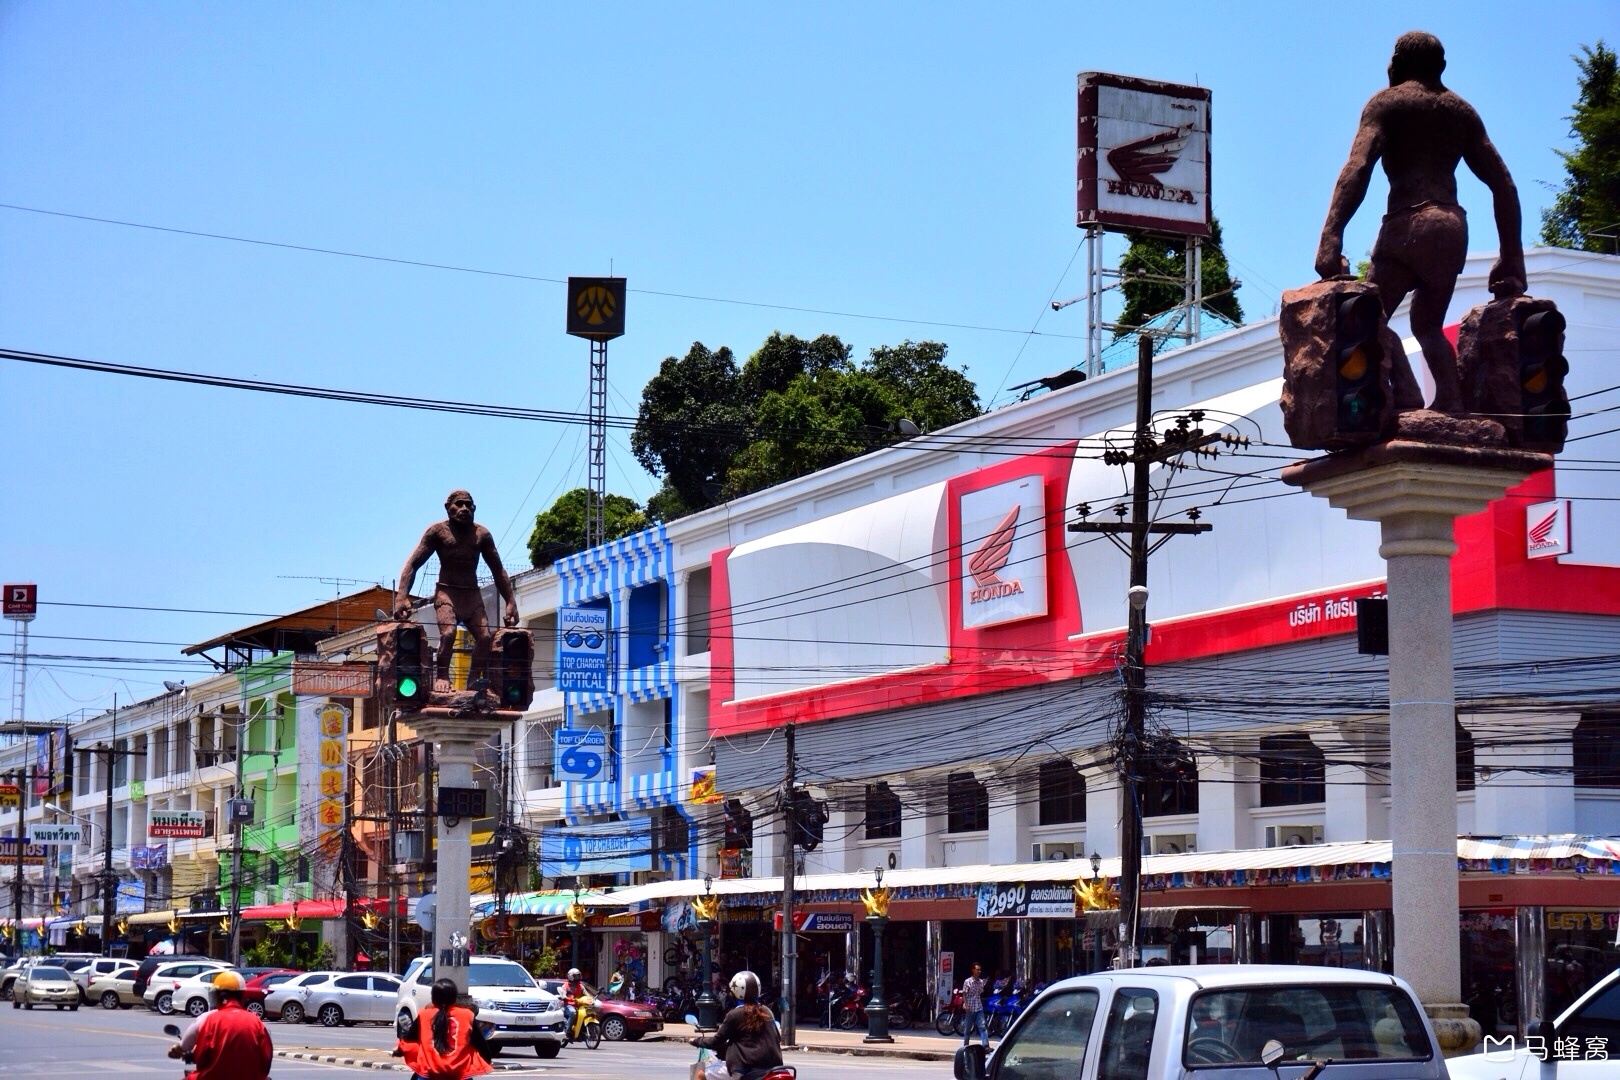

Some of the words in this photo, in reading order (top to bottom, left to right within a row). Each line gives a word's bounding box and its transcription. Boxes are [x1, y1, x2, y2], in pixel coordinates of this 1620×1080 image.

[1107, 179, 1198, 205] HONDA
[1529, 540, 1560, 550] HONDA
[969, 580, 1024, 604] HONDA
[1289, 602, 1321, 627] บริษัท
[562, 656, 576, 669] TOP
[562, 671, 605, 689] OPTICAL
[559, 735, 573, 744] TOP
[152, 812, 203, 827] หมอพีระ
[584, 838, 597, 853] TOP
[989, 882, 1026, 916] 2990
[1547, 912, 1604, 931] LET'S
